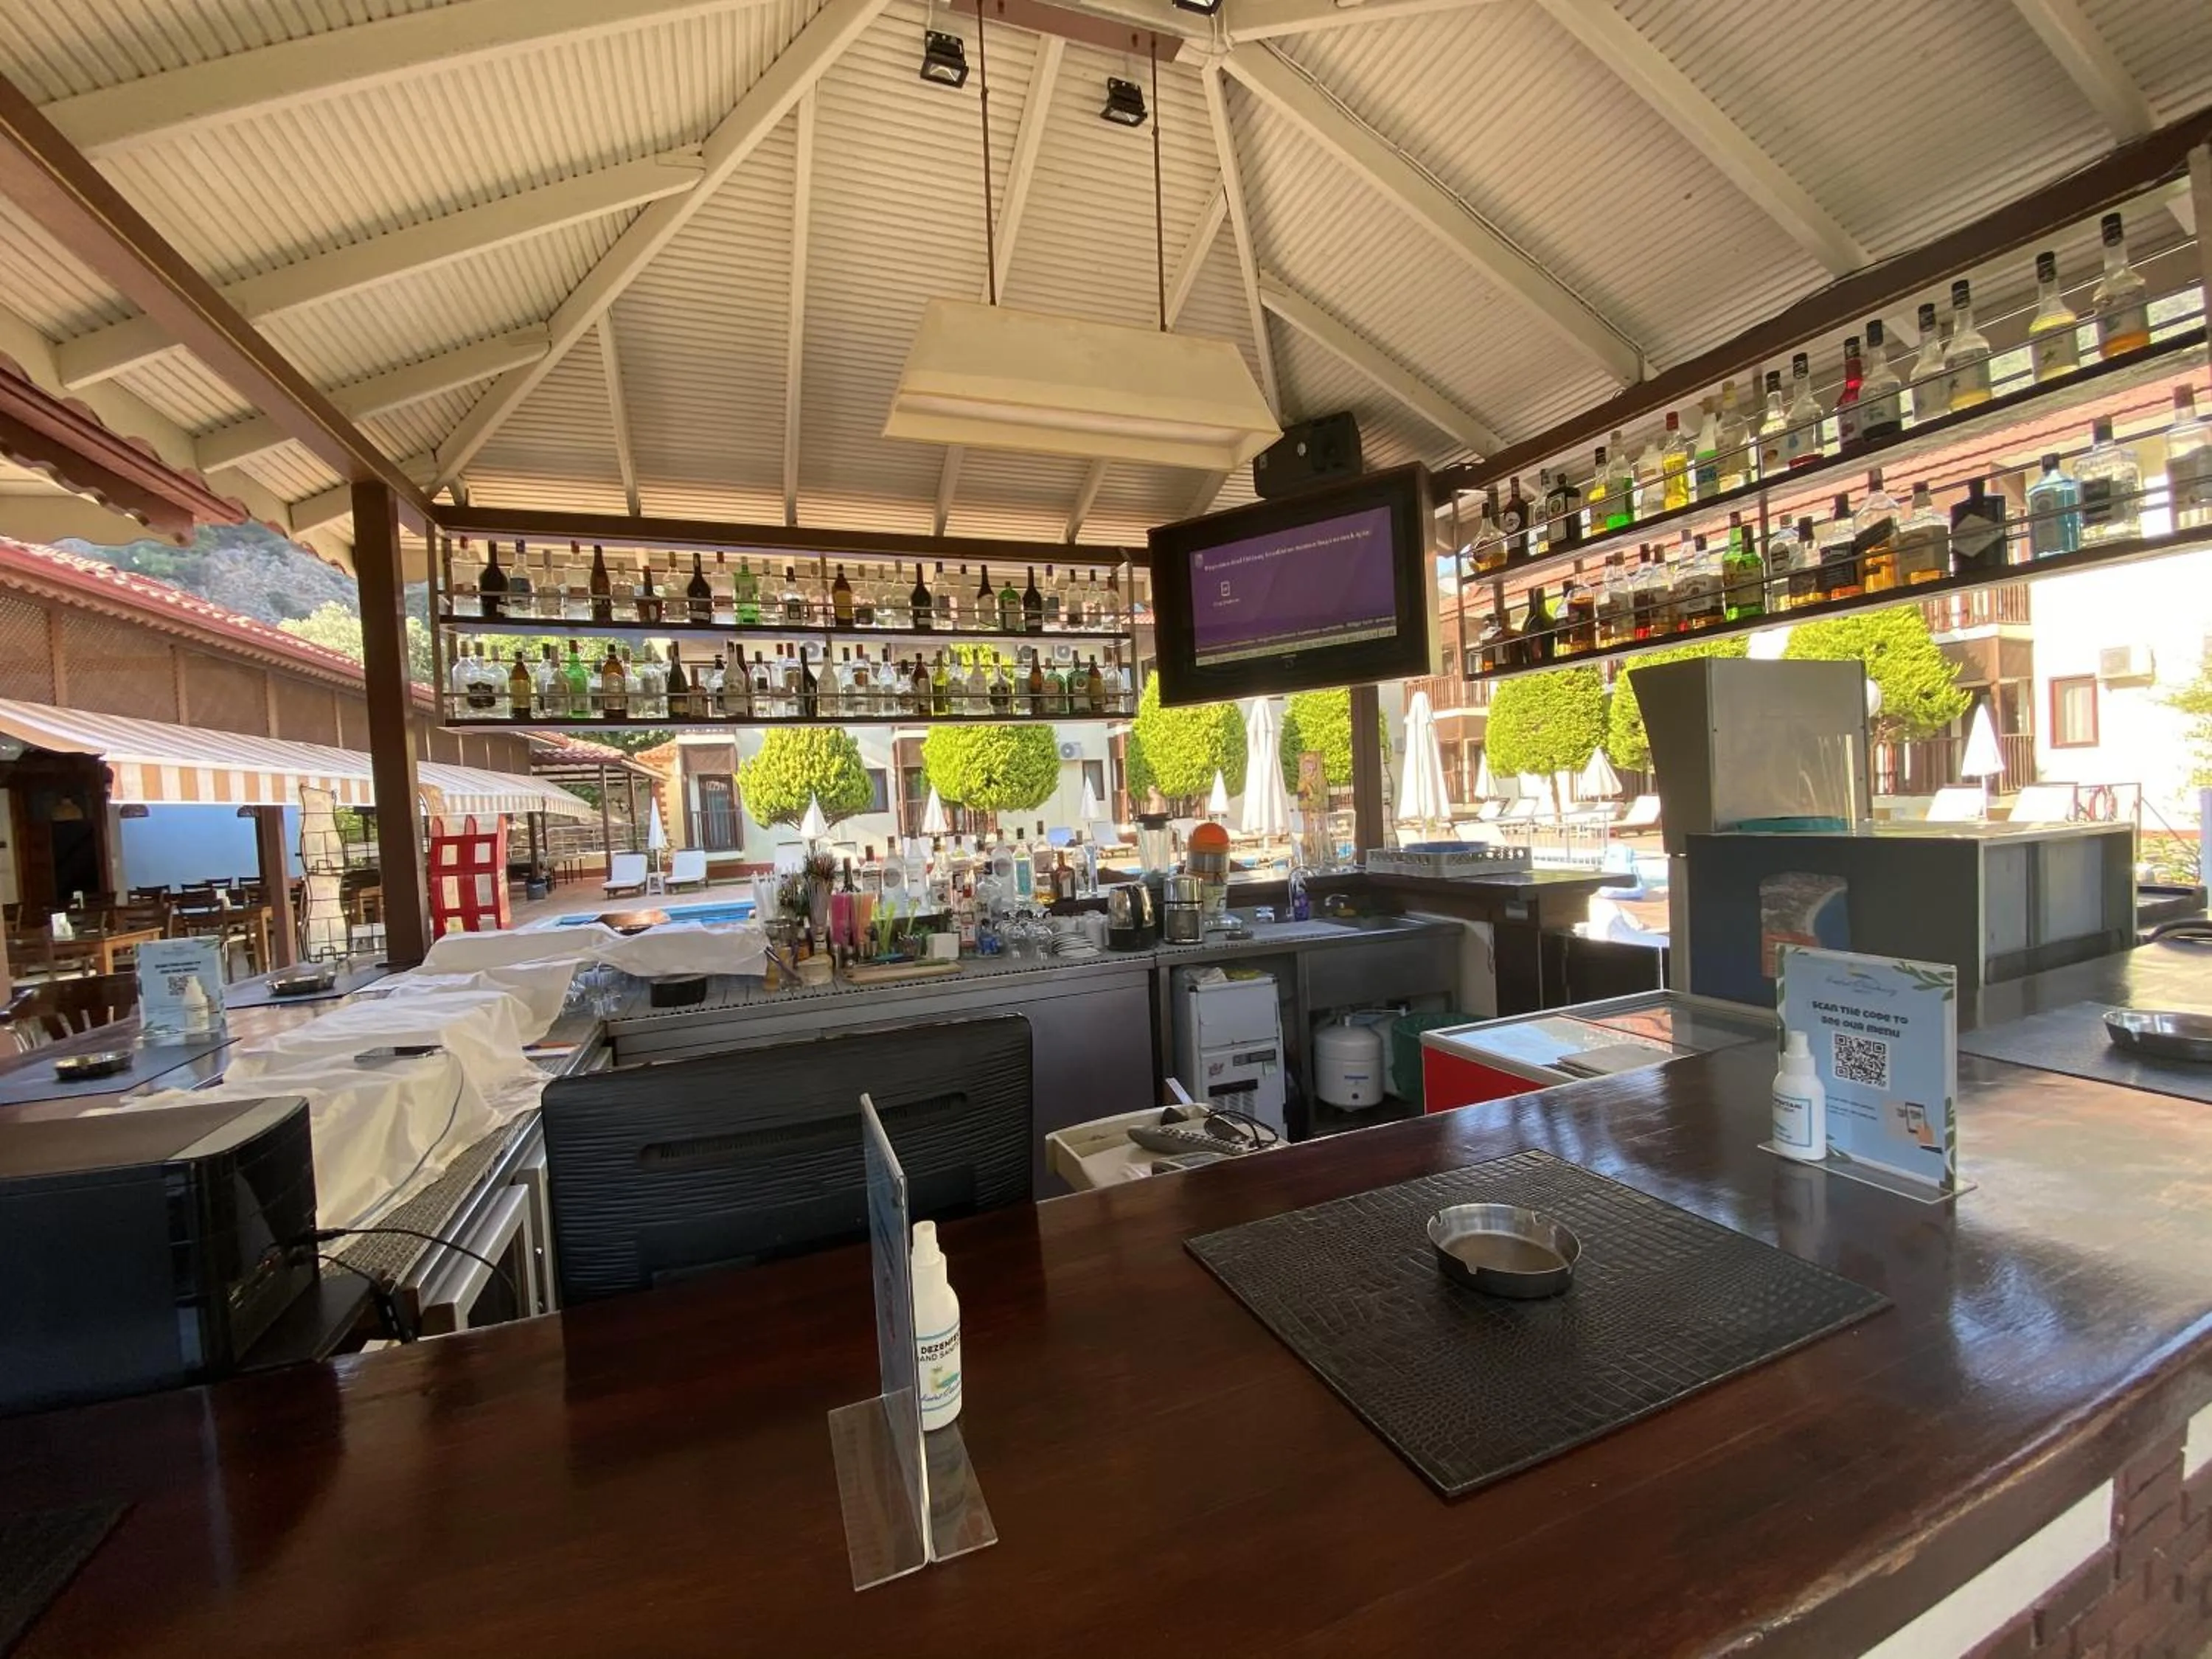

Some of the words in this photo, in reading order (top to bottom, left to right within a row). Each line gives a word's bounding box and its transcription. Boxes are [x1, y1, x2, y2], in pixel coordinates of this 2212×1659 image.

[1812, 1001, 1838, 1012] SCAN
[1840, 1006, 1861, 1016] THE
[1863, 1010, 1891, 1022] CODE
[1893, 1015, 1909, 1024] TO
[1842, 1020, 1864, 1030] OUR
